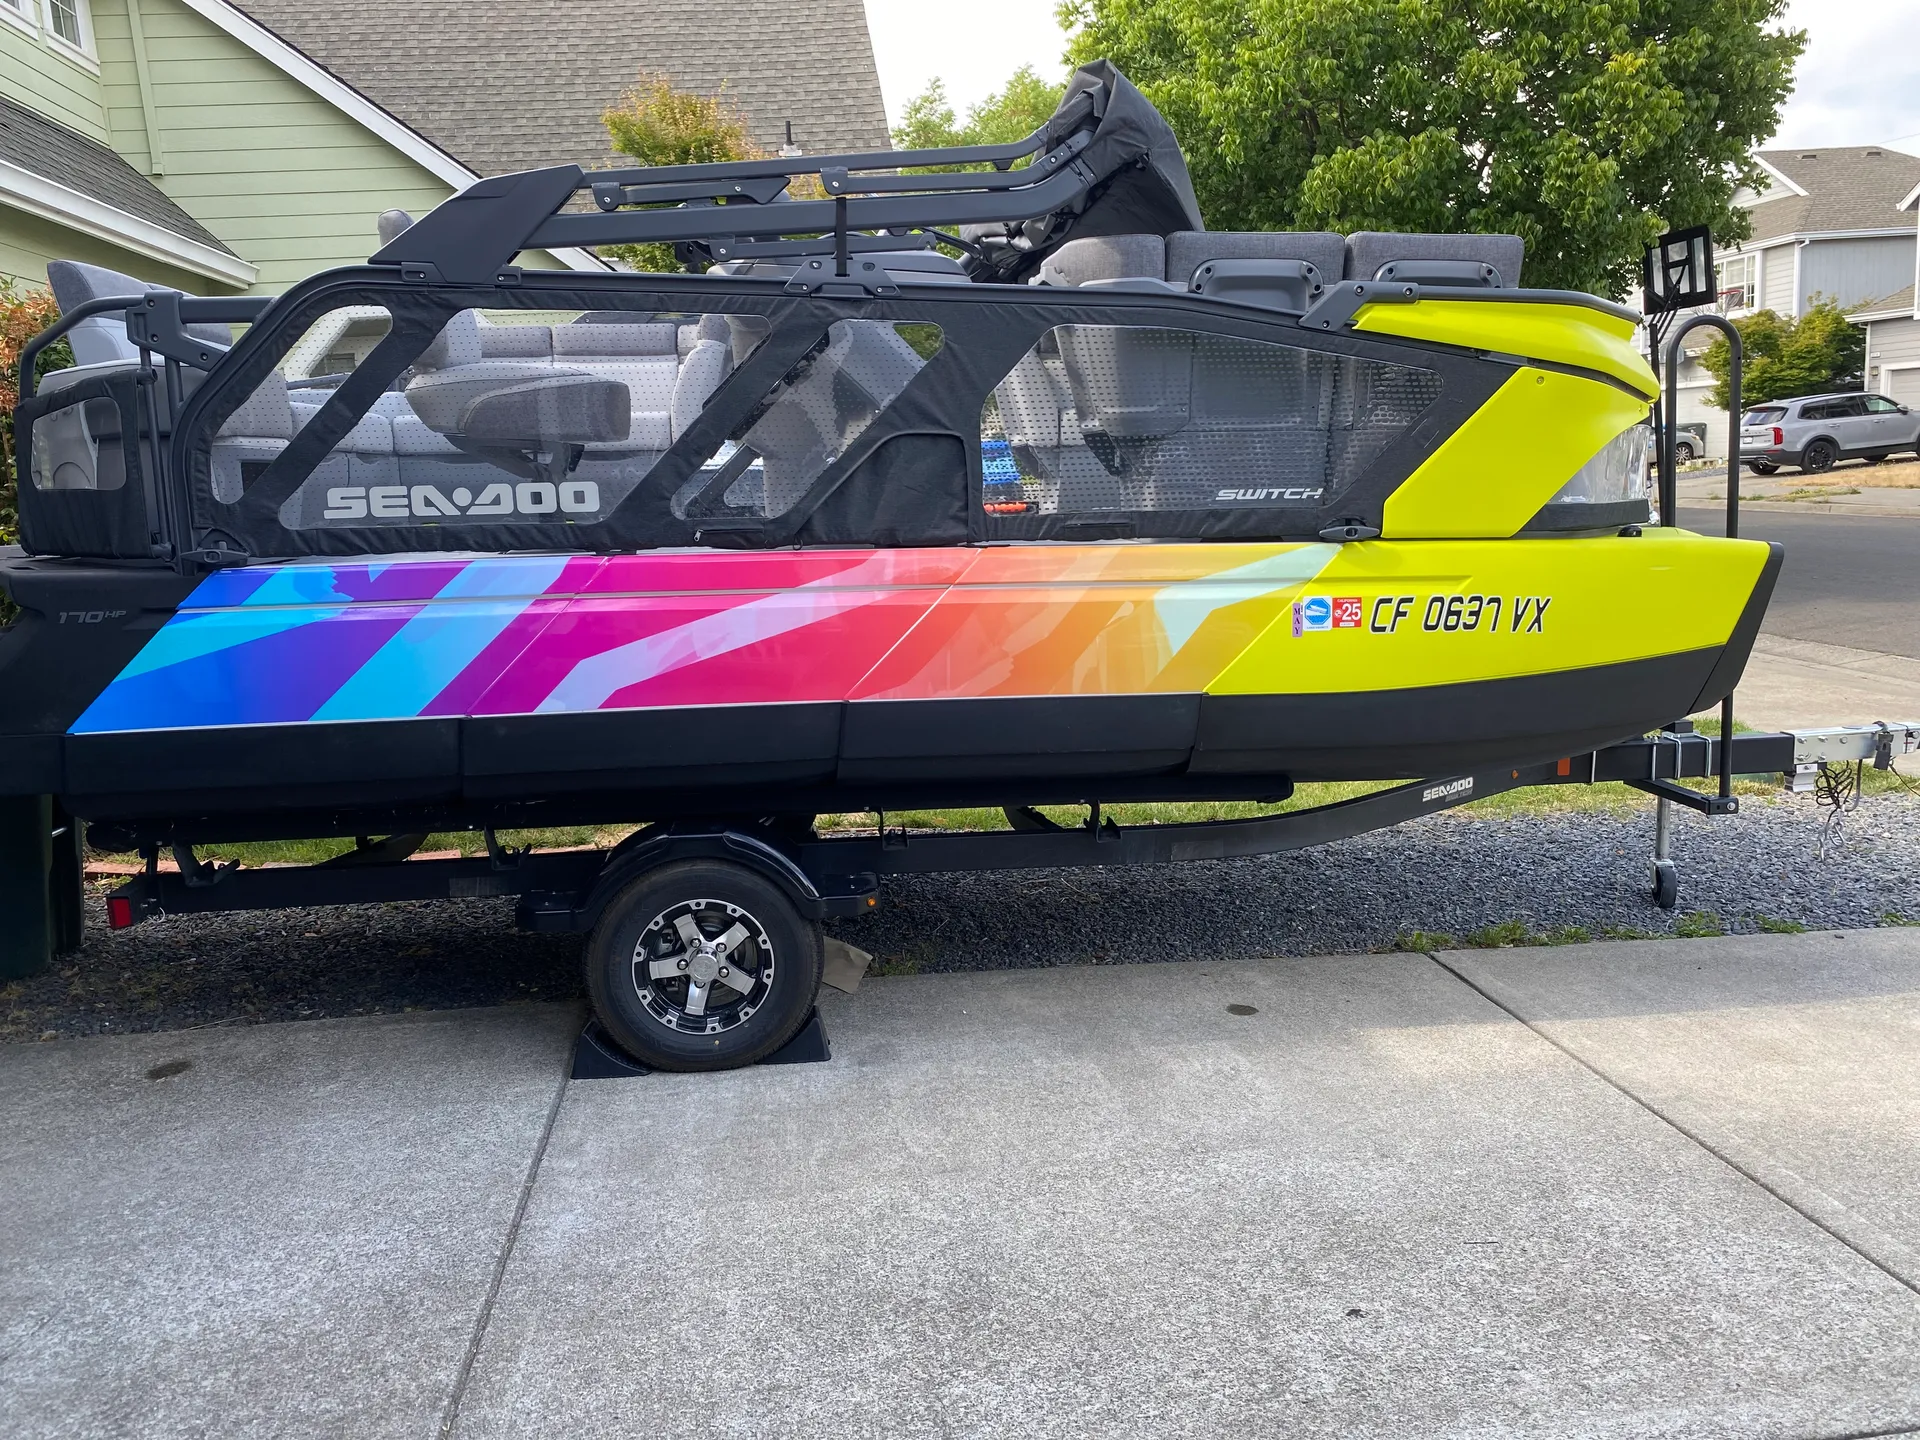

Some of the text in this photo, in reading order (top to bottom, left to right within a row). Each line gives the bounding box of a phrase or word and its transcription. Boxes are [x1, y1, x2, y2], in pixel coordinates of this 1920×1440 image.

[1215, 487, 1324, 502] SWITCH
[1293, 607, 1302, 635] MAY
[1341, 603, 1362, 621] 25
[1370, 594, 1553, 634] CF 0637 VX
